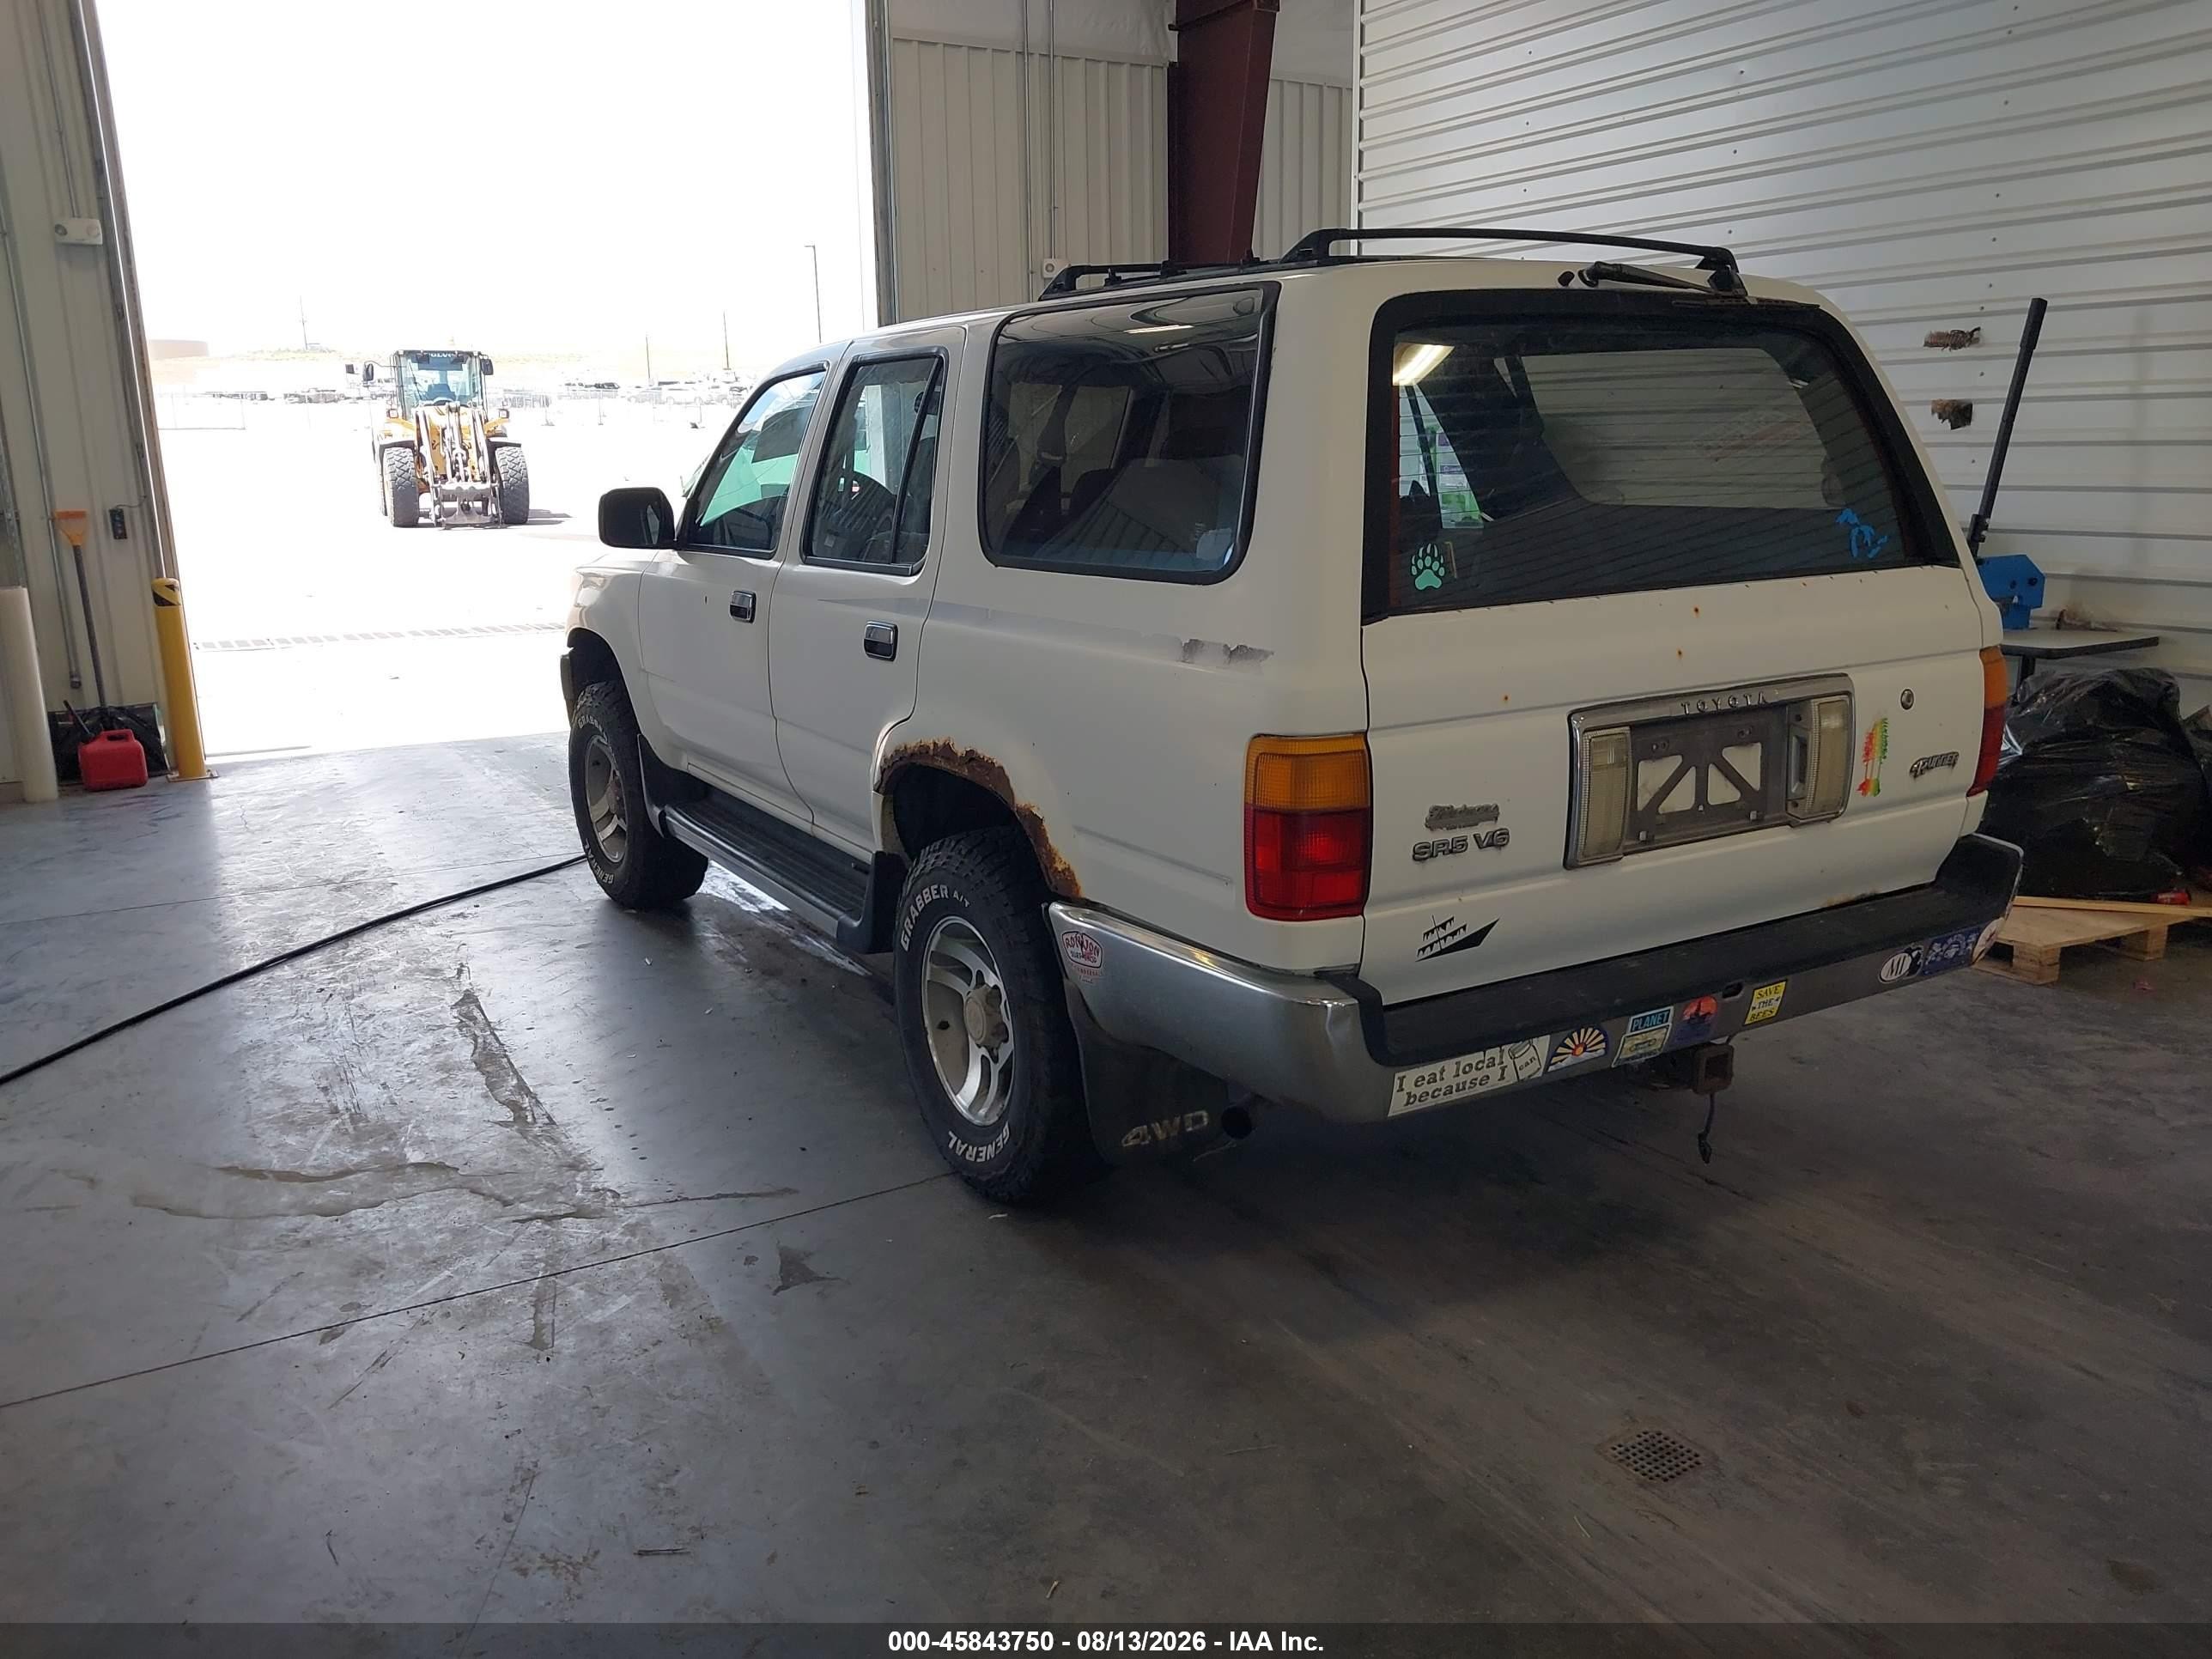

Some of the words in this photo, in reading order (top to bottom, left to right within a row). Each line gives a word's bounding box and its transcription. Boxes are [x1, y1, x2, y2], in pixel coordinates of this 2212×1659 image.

[1680, 691, 1768, 715] TOYOTA
[1412, 836, 1468, 861] SR5
[1473, 828, 1510, 849] V6
[900, 884, 949, 952] GRABBER
[952, 890, 970, 908] A/T
[1756, 985, 1780, 999] SAVE
[1632, 1009, 1669, 1031] PLANET
[1396, 1075, 1407, 1093] I
[1413, 1065, 1446, 1090] eat
[1453, 1045, 1506, 1079] local
[1518, 1054, 1537, 1072] can
[1403, 1073, 1491, 1108] because
[1498, 1065, 1509, 1082] I
[948, 1120, 1010, 1163] GENERAL
[1121, 1110, 1209, 1147] 4WD
